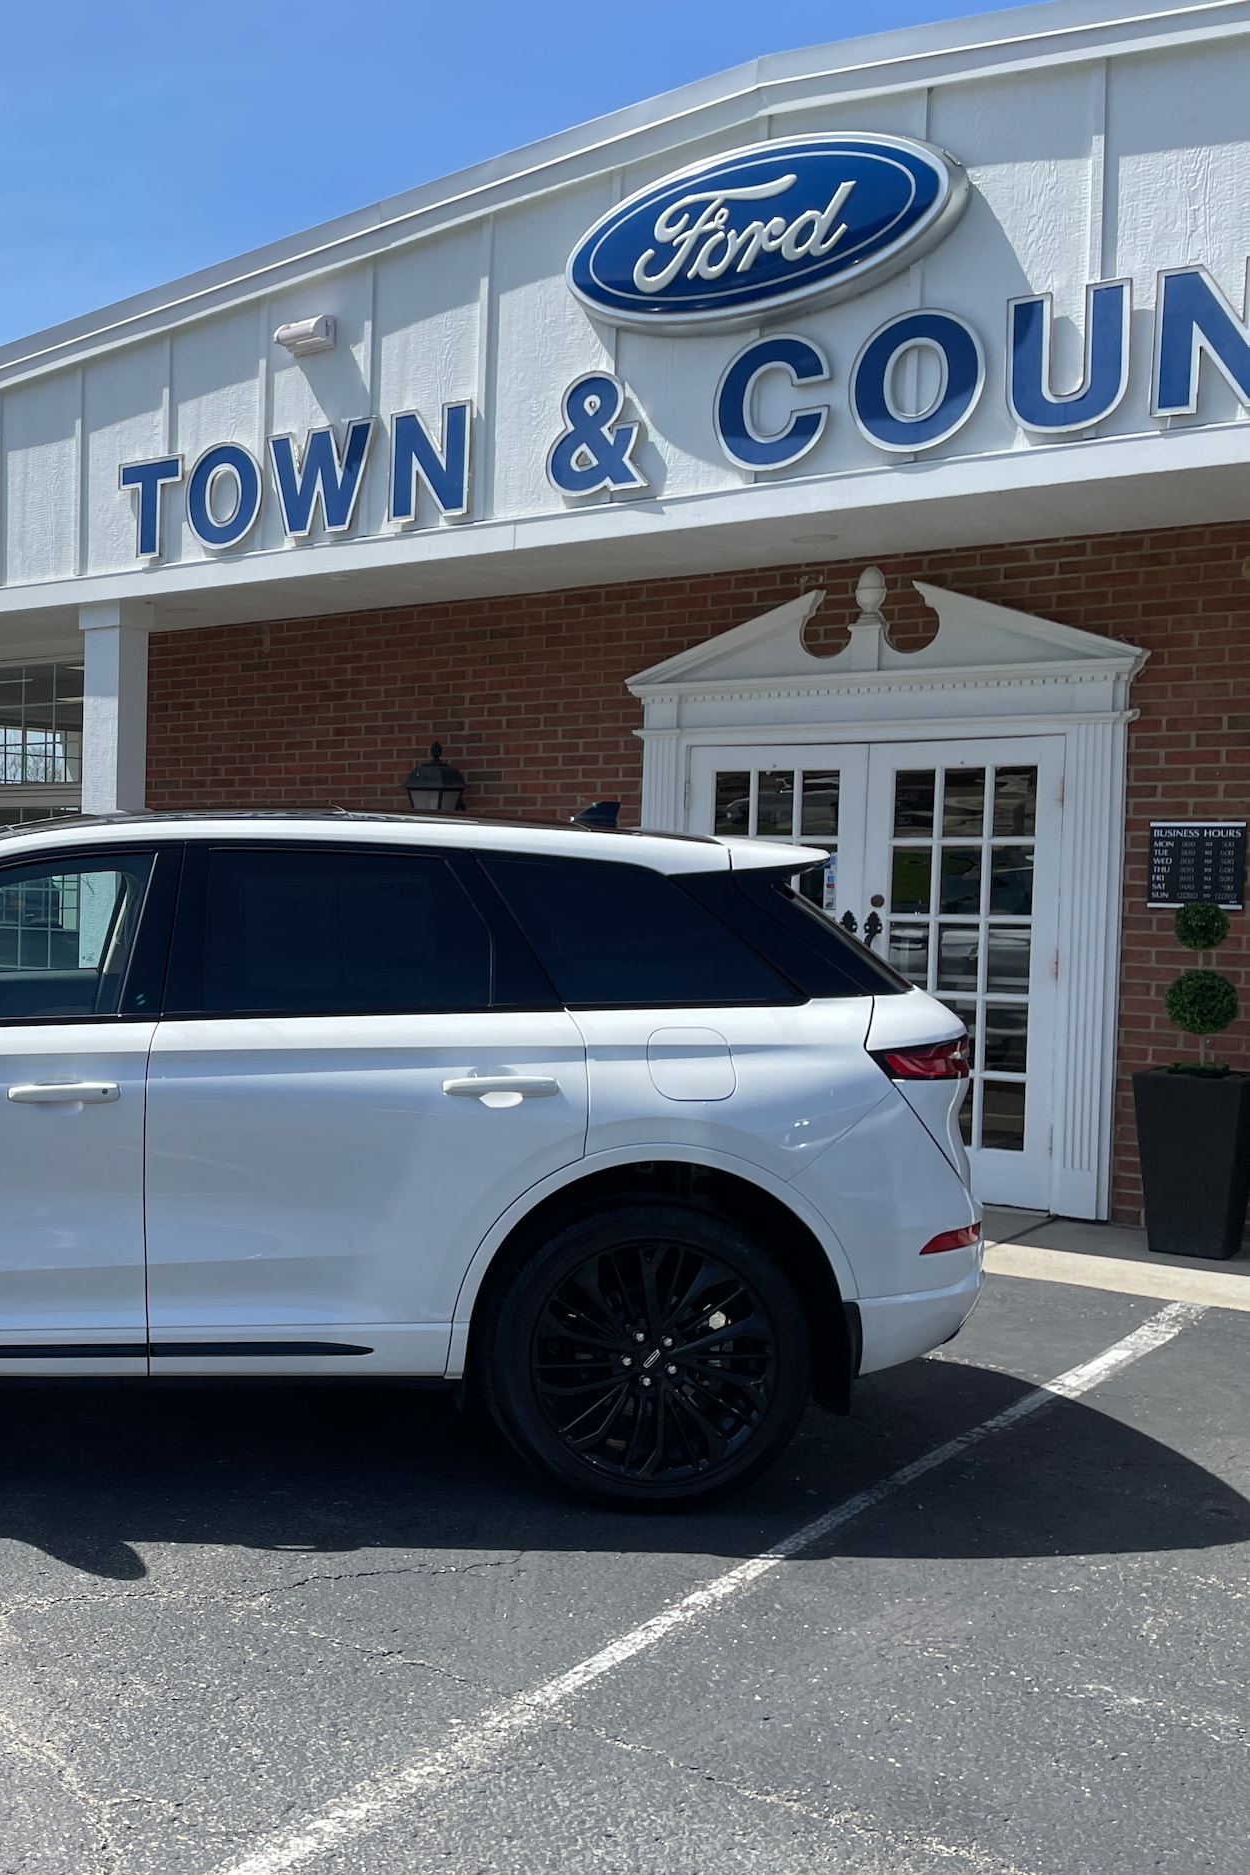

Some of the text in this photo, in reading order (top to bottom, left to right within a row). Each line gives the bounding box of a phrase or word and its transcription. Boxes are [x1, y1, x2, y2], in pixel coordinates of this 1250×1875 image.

[633, 173, 856, 294] Ford
[118, 255, 1250, 559] TOWN & COUN
[1153, 829, 1242, 838] BUSINESS HOURS
[1153, 857, 1173, 865] WED
[1152, 874, 1165, 882] FRI
